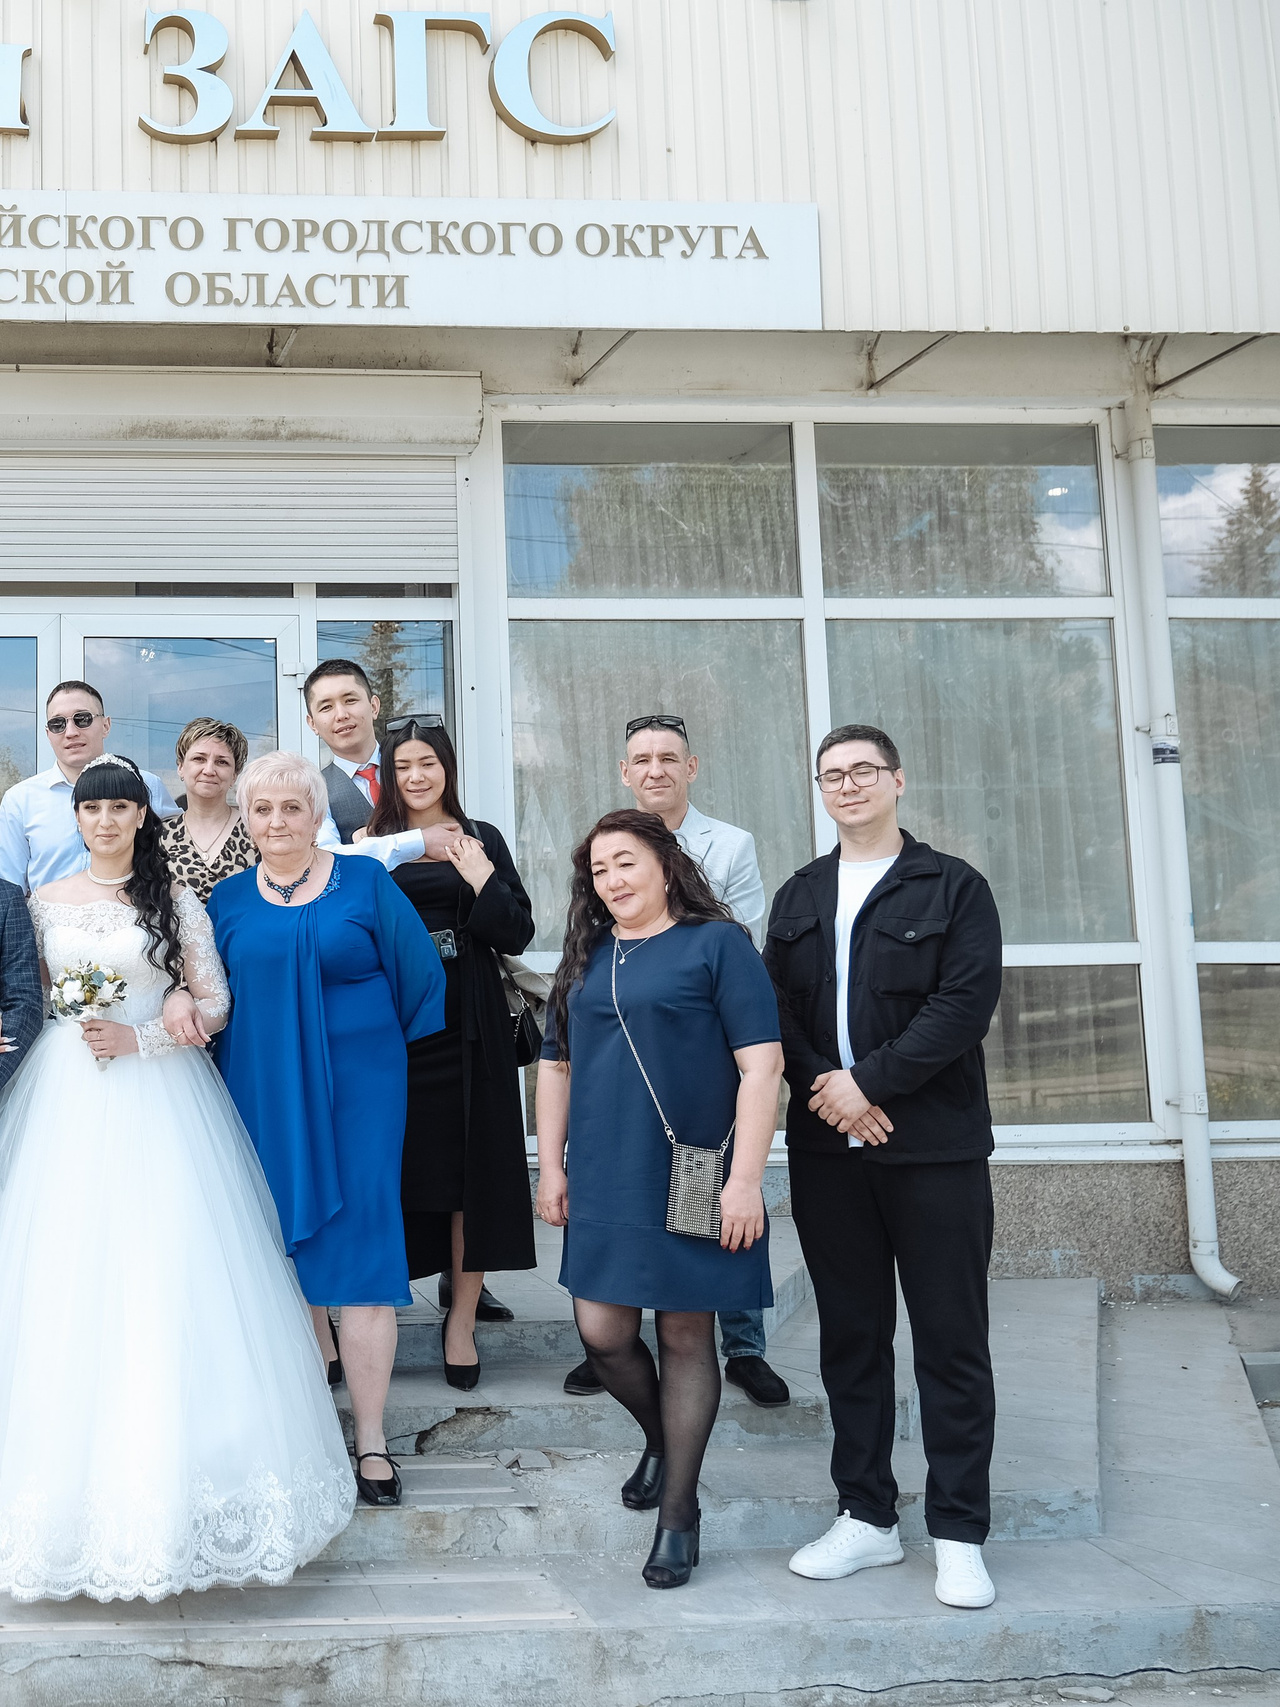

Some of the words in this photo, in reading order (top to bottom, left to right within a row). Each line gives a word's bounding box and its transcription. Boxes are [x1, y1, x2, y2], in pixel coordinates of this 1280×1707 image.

[138, 8, 617, 145] ЗАГС
[222, 217, 564, 262] ГОРОДСКОГО
[575, 222, 770, 260] ОКРУГА
[164, 272, 410, 309] ОБЛАСТИ
